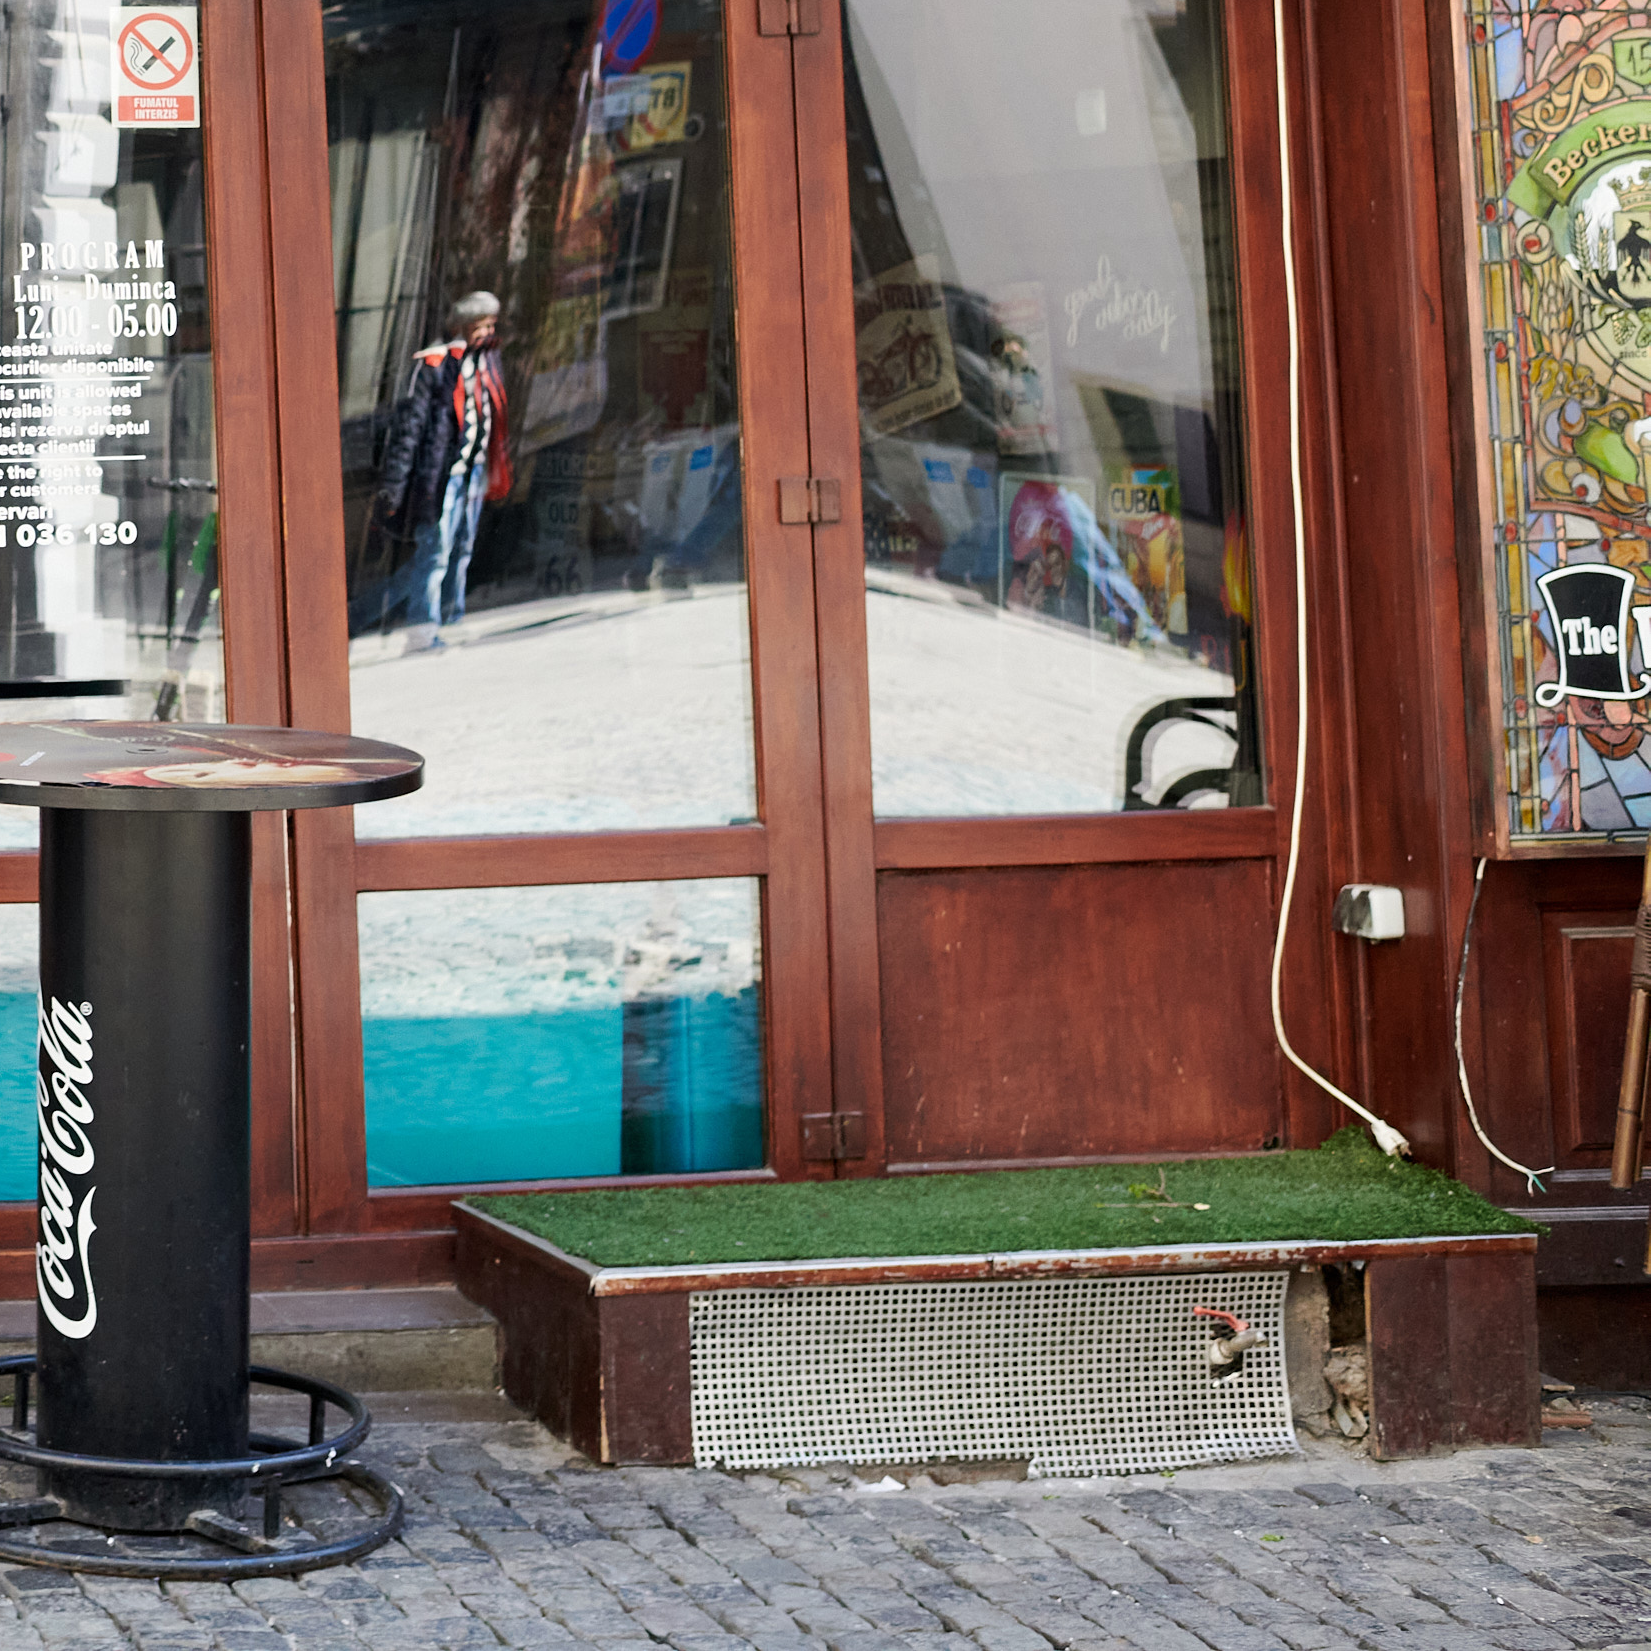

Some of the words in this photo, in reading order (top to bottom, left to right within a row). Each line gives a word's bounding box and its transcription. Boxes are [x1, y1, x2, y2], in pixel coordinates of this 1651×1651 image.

[133, 97, 180, 109] FUMATUL
[134, 108, 179, 120] INTERZIS
[20, 239, 165, 271] PROGRAM
[13, 274, 59, 303] Luni
[85, 273, 177, 301] Duminca
[15, 304, 84, 340] 12.00
[107, 303, 178, 338] 05.00
[52, 340, 113, 357] unitate
[61, 358, 155, 378] disponibile
[18, 385, 53, 401] unit
[73, 383, 142, 400] allowed
[87, 419, 150, 439] dreptul
[7, 465, 36, 481] the
[1110, 487, 1162, 515] CUBA
[15, 523, 75, 549] 036
[85, 520, 139, 546] 130
[1562, 616, 1618, 656] The
